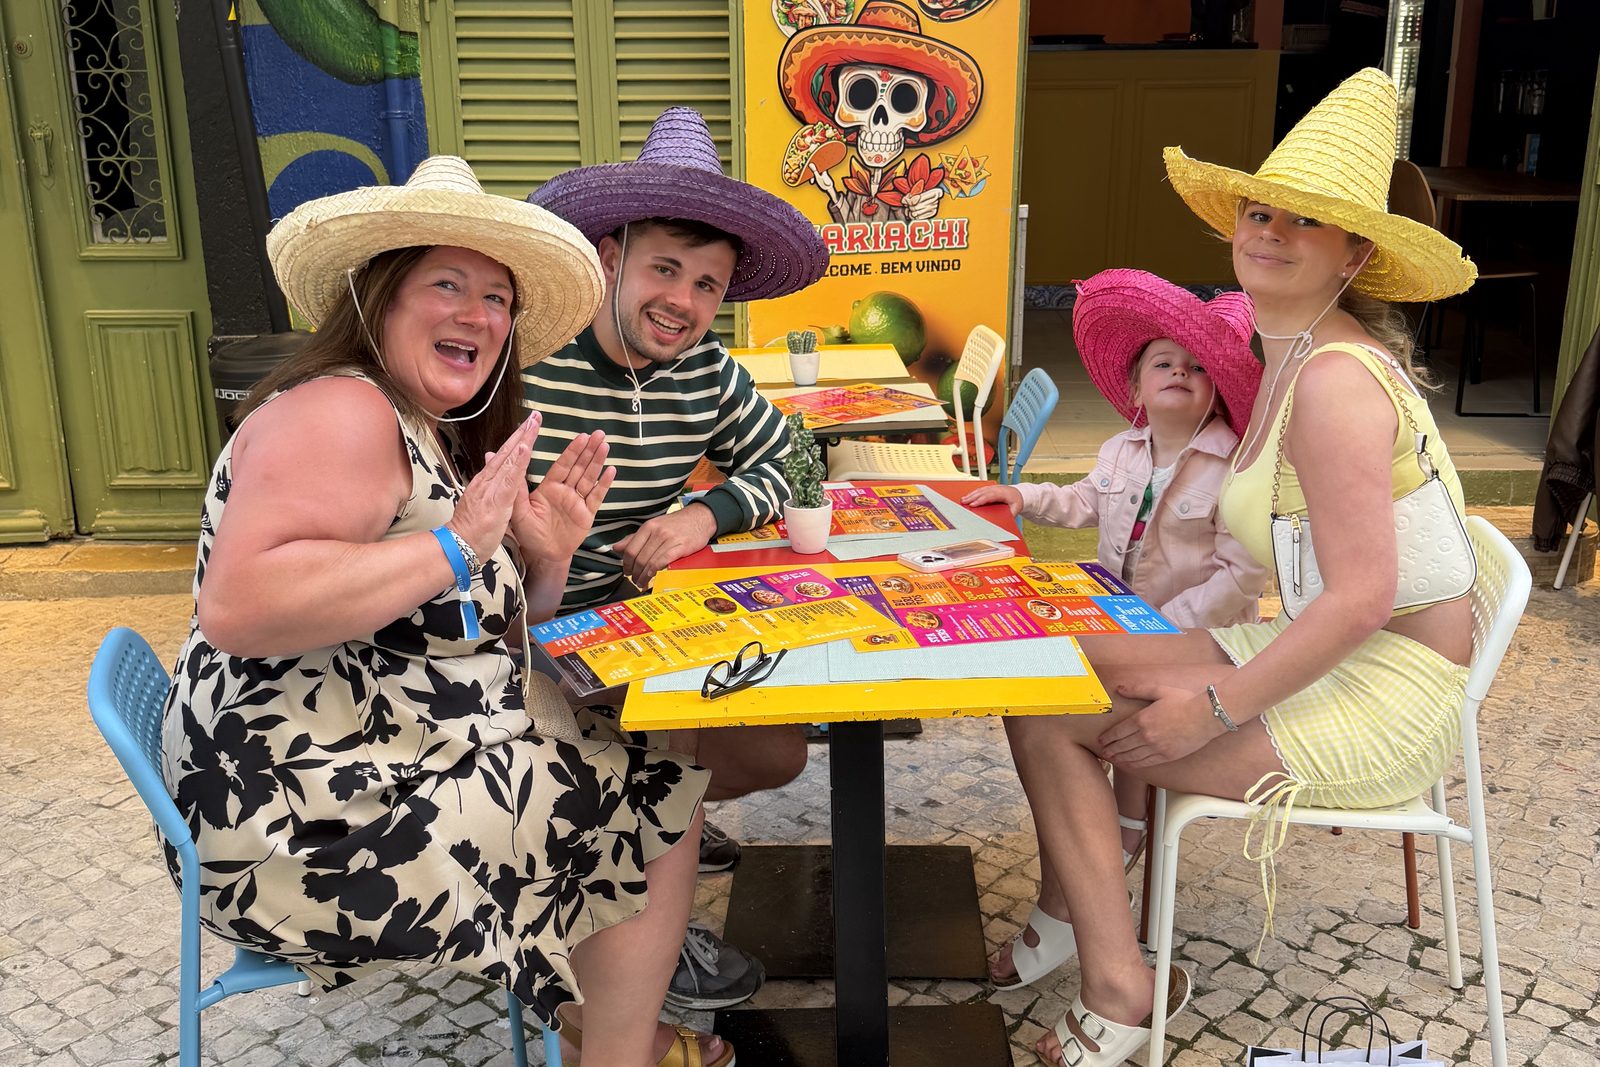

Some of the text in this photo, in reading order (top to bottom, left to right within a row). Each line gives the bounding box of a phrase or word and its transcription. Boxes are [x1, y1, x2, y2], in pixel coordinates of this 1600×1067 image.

[814, 218, 969, 255] ARIACHI
[824, 259, 961, 277] COME BEM VINDO
